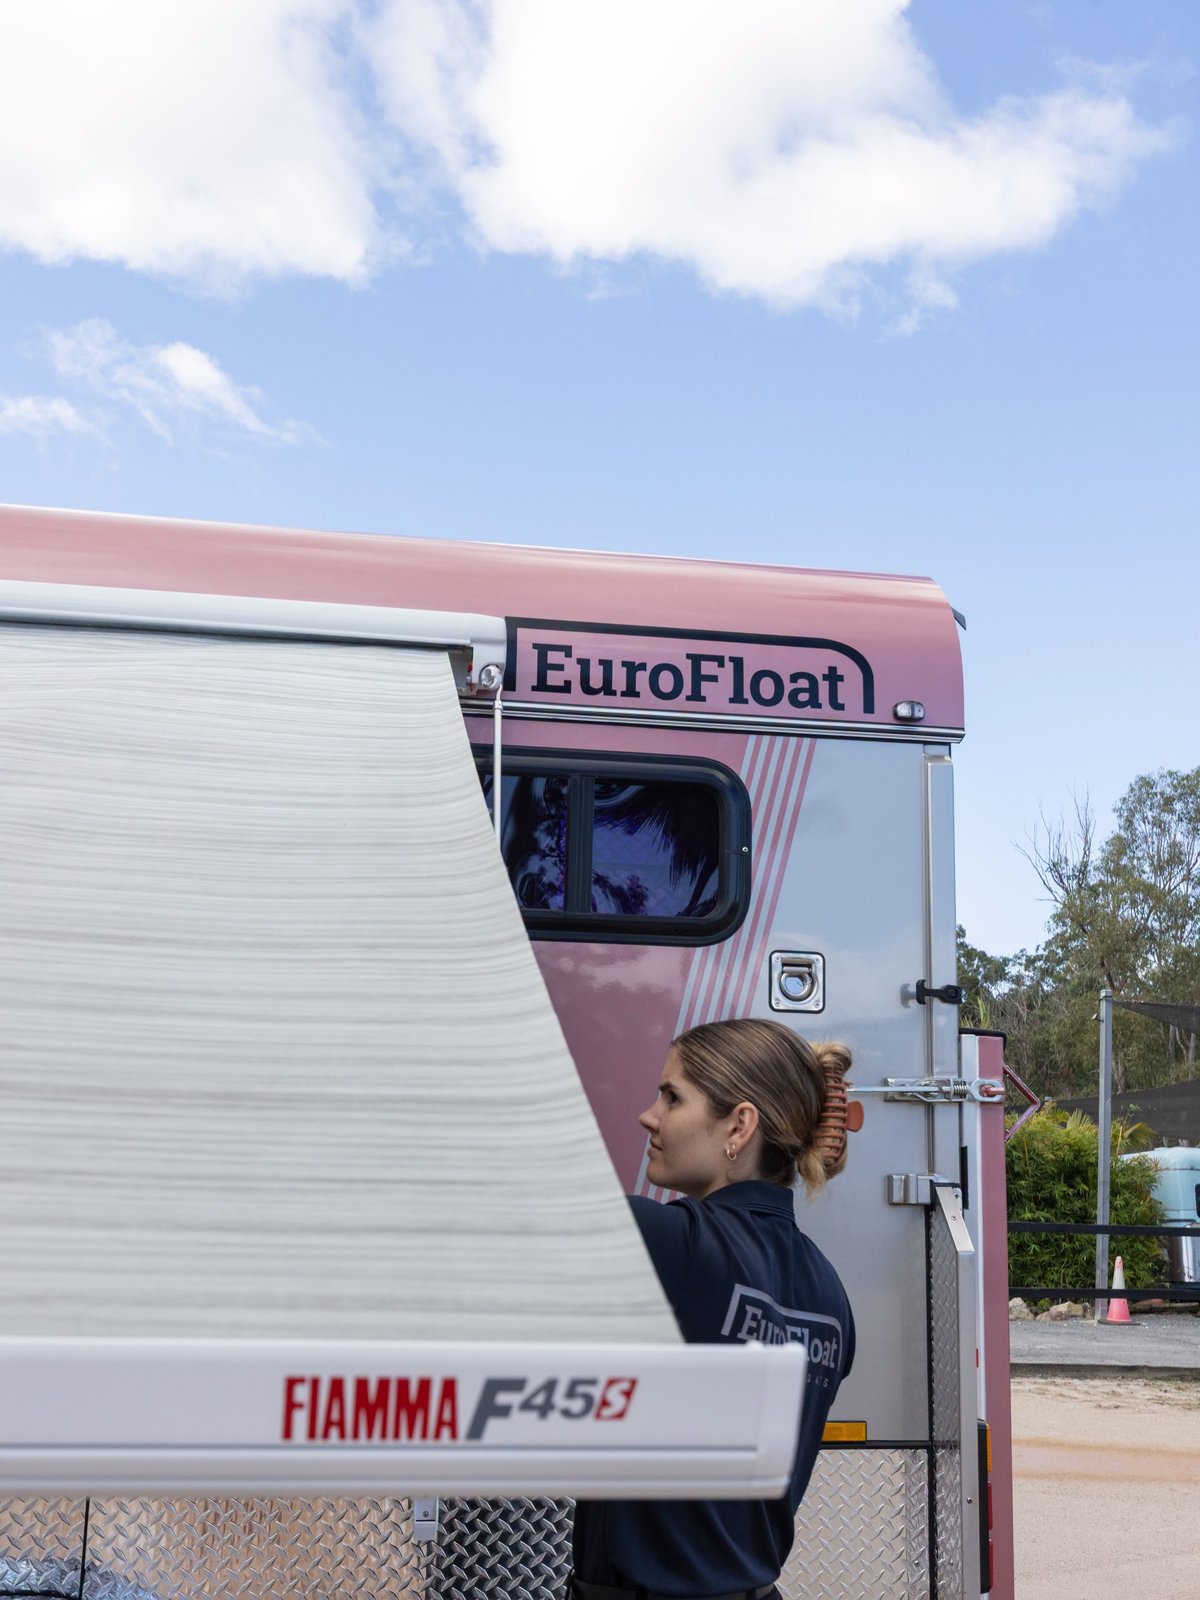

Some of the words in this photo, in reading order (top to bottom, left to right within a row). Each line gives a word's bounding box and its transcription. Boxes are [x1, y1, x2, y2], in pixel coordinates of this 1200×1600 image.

[531, 643, 846, 712] EuroFloat
[281, 1376, 459, 1441] FIAMMA
[465, 1378, 639, 1440] F45S
